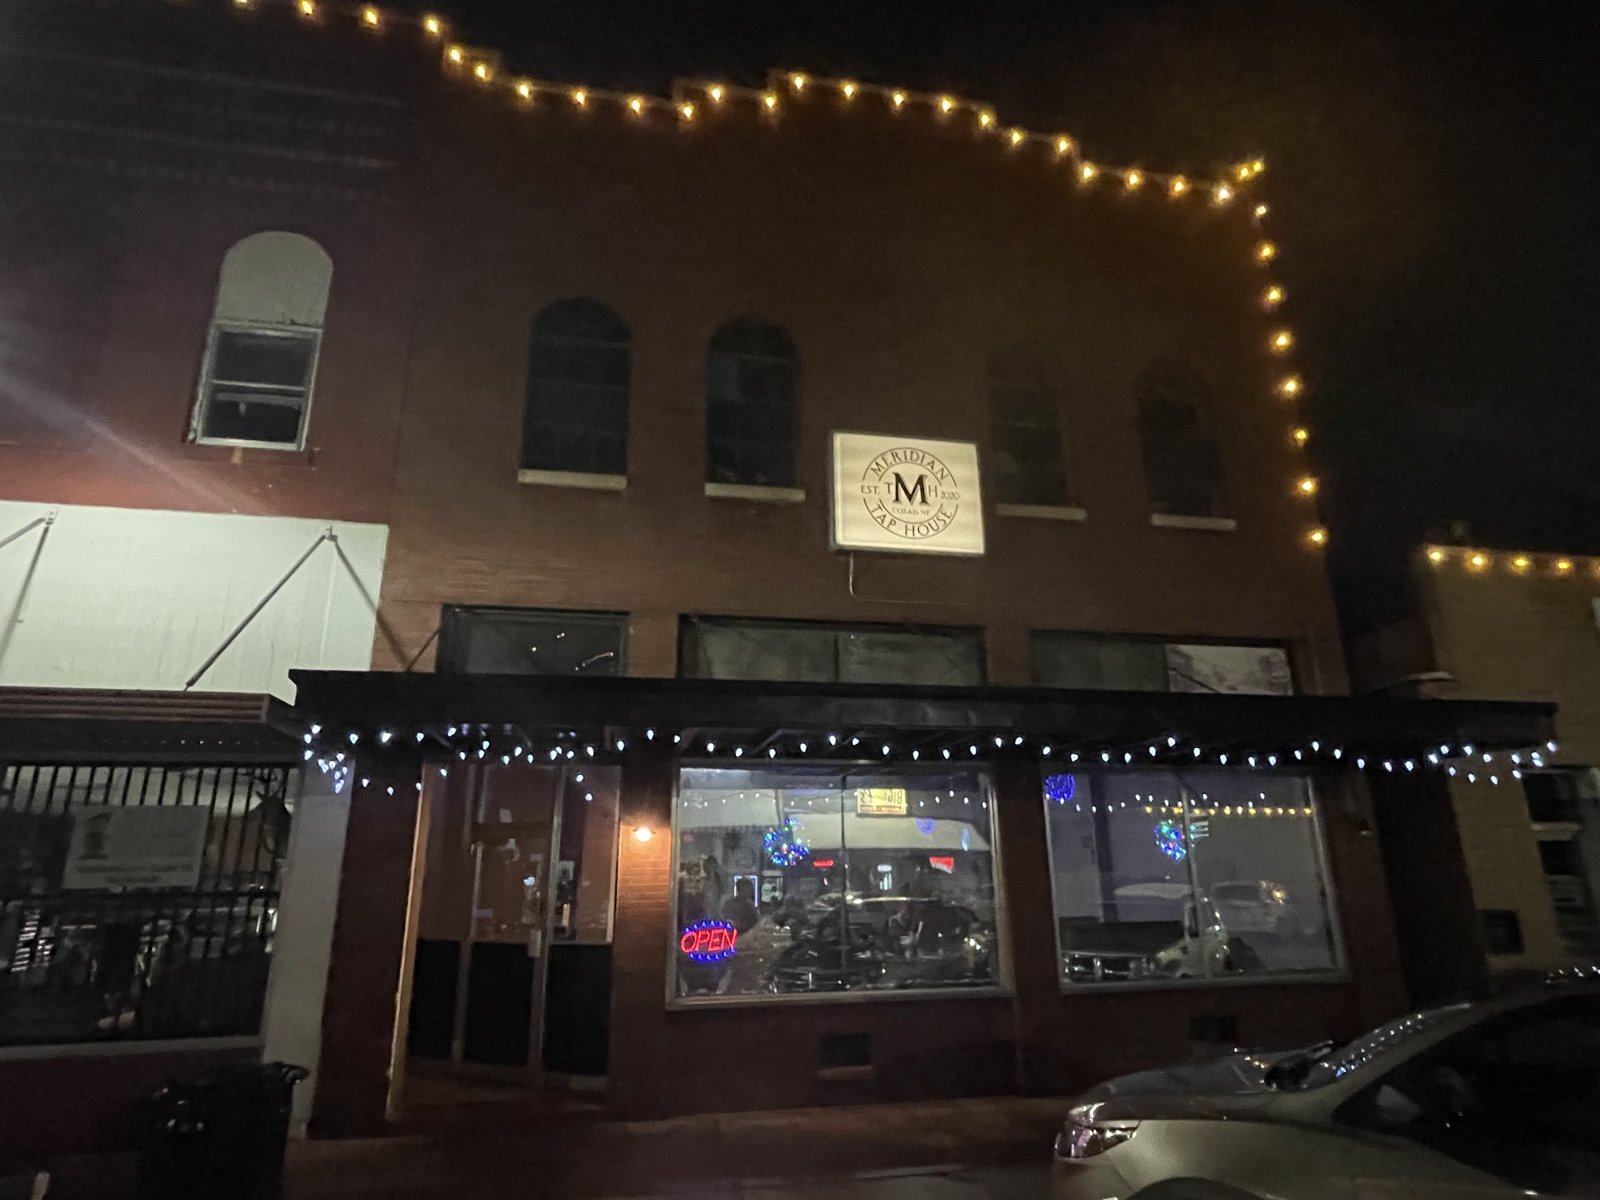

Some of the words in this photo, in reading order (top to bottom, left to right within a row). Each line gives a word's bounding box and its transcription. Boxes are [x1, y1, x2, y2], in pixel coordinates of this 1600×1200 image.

[870, 449, 949, 481] MERIDIAN
[860, 484, 881, 495] EST.
[941, 490, 960, 500] 2020
[871, 503, 897, 529] TAP
[905, 509, 953, 537] HOUSE
[681, 928, 738, 953] OPEN
